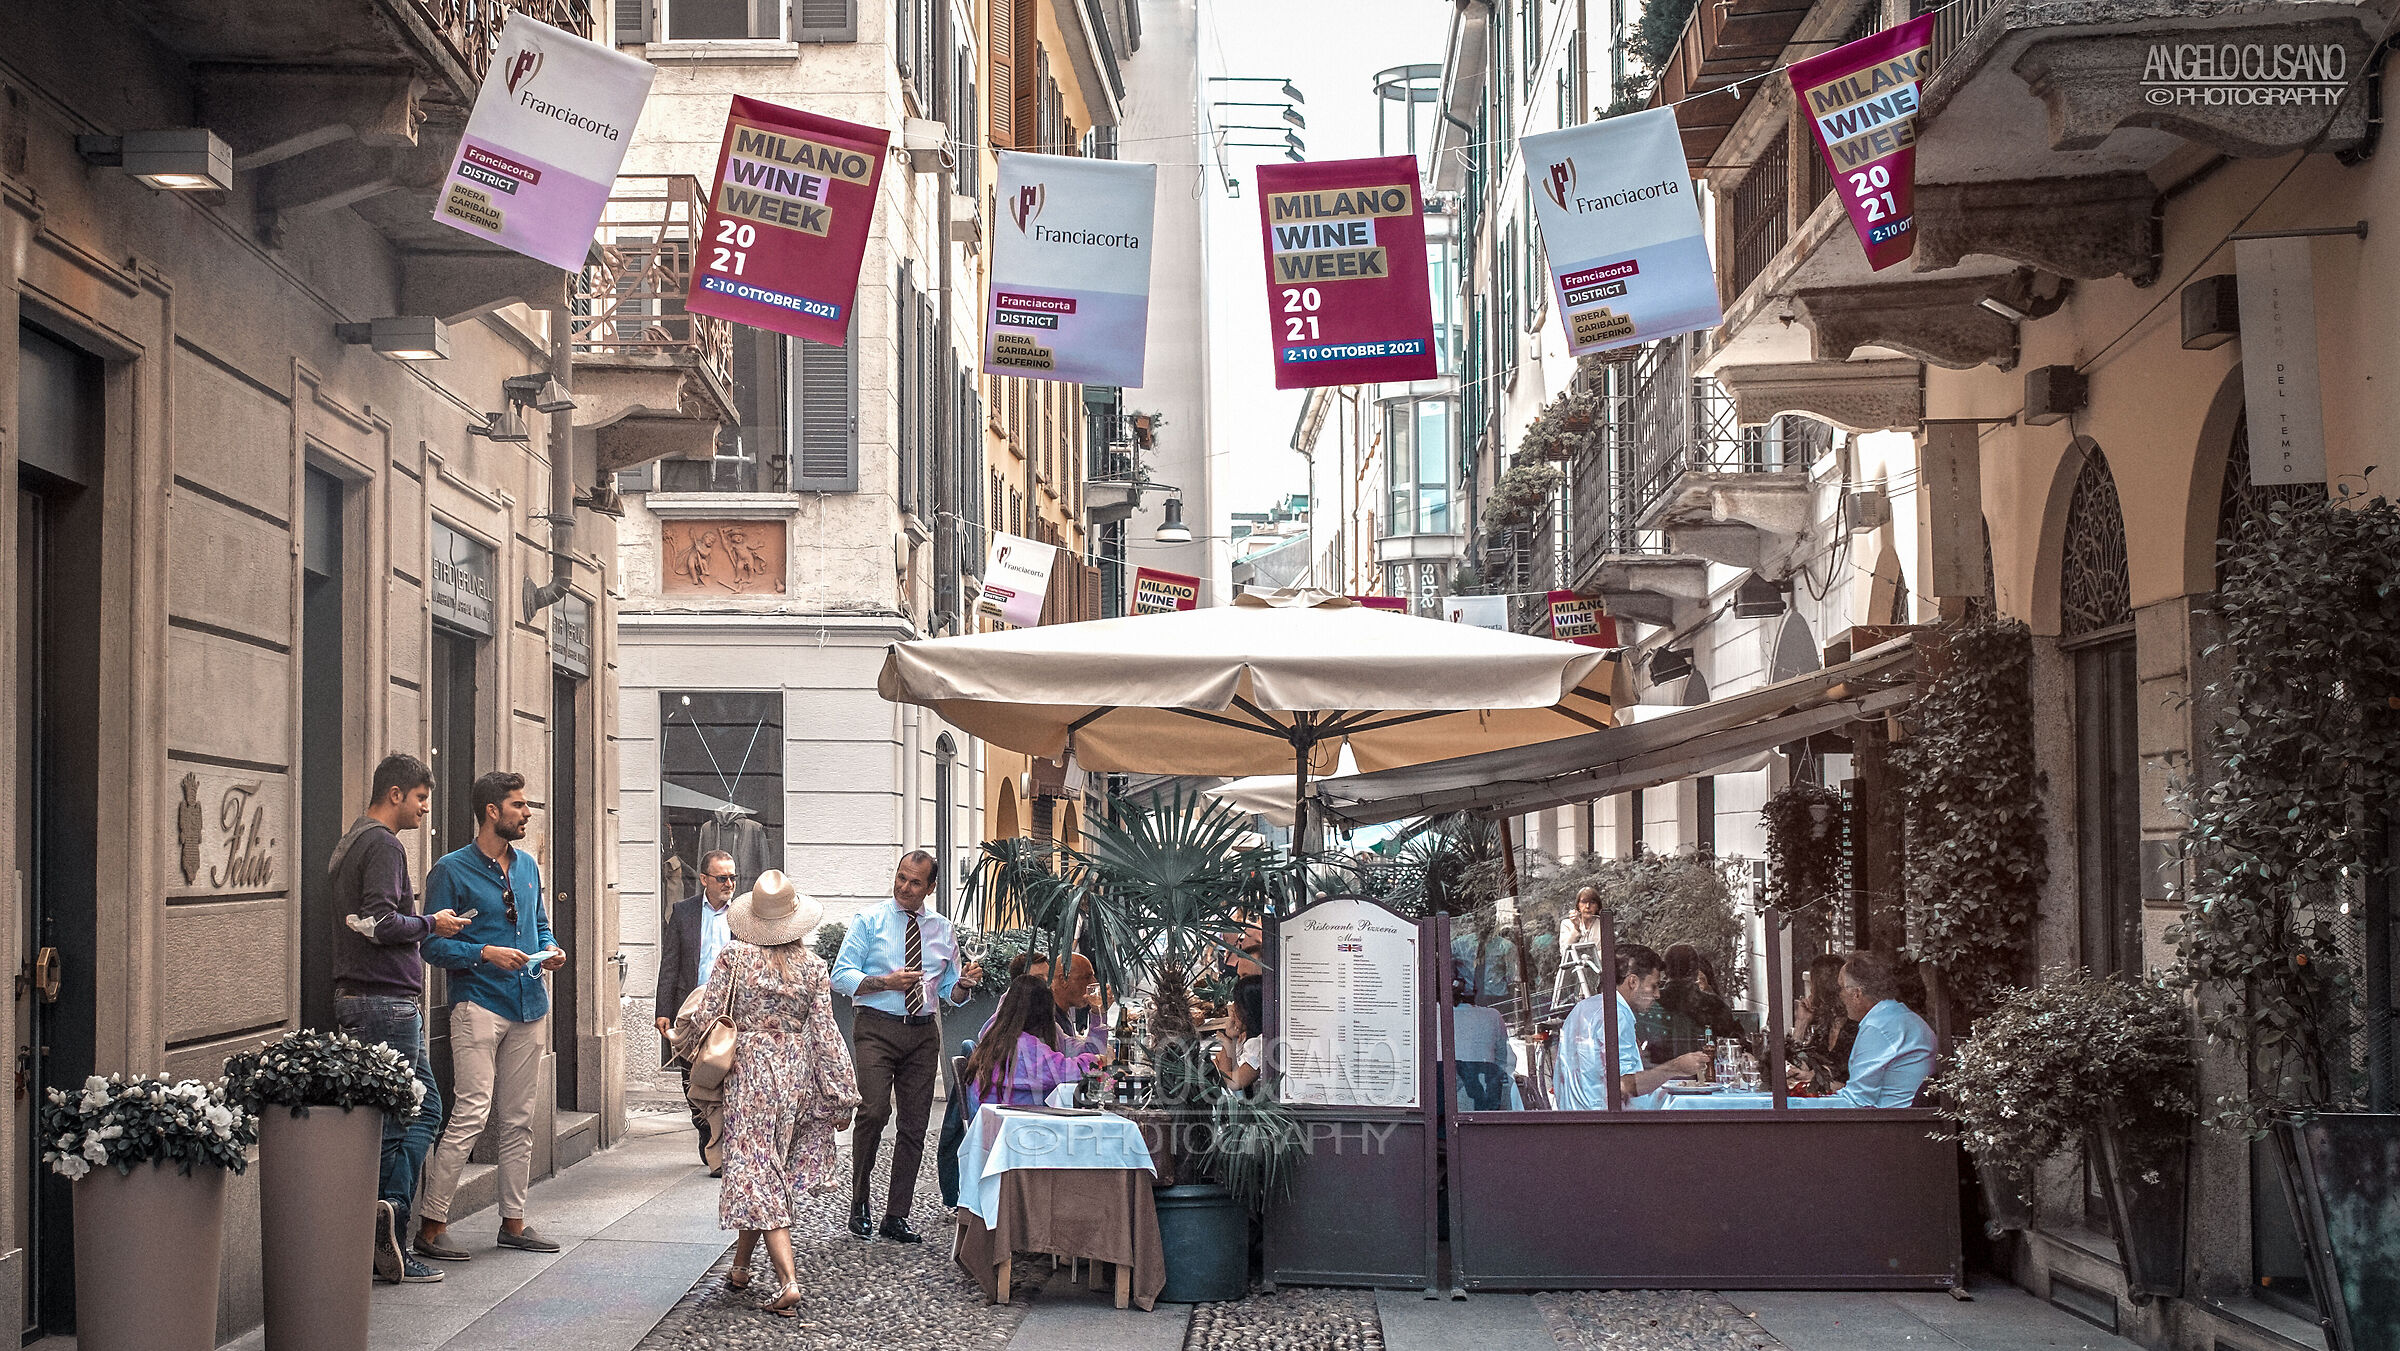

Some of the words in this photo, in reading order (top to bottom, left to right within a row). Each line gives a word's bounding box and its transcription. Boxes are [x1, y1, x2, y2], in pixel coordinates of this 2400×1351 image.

[520, 90, 619, 141] Franciacorta
[1822, 88, 1917, 139] WINE
[736, 129, 867, 178] MILANO
[1834, 117, 1918, 166] WEE
[469, 150, 535, 181] Franciacorta
[462, 165, 515, 192] DISTRICT
[732, 158, 822, 201] WINE
[1848, 165, 1890, 198] 20
[454, 185, 486, 203] BRERA
[1275, 188, 1406, 220] MILANO
[1576, 178, 1679, 215] Franciacorta
[447, 206, 499, 230] SOLFERINO
[451, 195, 500, 219] GARIBALDI
[726, 187, 826, 232] WEEK
[1860, 192, 1897, 222] 21
[715, 219, 756, 248] 20
[1035, 224, 1140, 249] Franciacorta
[1276, 221, 1369, 250] WINE
[1872, 223, 1898, 242] 2-10
[710, 247, 747, 276] 21
[1278, 250, 1384, 280] WEEK
[1564, 263, 1633, 287] Franciacorta
[704, 277, 735, 294] 2-10
[737, 286, 802, 310] OTTOBRE
[804, 301, 836, 318] 2021
[1001, 295, 1071, 311] Franciacorta
[1281, 287, 1321, 313] 20
[1568, 283, 1622, 303] DISTRICT
[999, 313, 1053, 327] DISTRICT
[1574, 309, 1607, 324] BRERA
[1576, 315, 1629, 335] GARIBALDI
[997, 334, 1032, 345] BRERA
[1285, 317, 1320, 341] 21
[1578, 325, 1632, 344] SOLFERINO
[995, 356, 1051, 369] SOLFERINO
[996, 344, 1050, 358] GARIBALDI
[1287, 346, 1318, 361] 2-10
[1320, 343, 1386, 359] OTTOBRE
[1388, 341, 1421, 355] 2021
[2276, 363, 2285, 397] DEL
[2279, 414, 2293, 473] TEMPO
[1003, 561, 1044, 578] Franciacorta
[1139, 591, 1175, 607] WINE
[1140, 580, 1192, 598] MILANO
[1555, 613, 1592, 625] WINE
[1557, 624, 1598, 637] WEEK
[1304, 919, 1354, 932] Ristorante
[1357, 919, 1398, 934] Pizzeria
